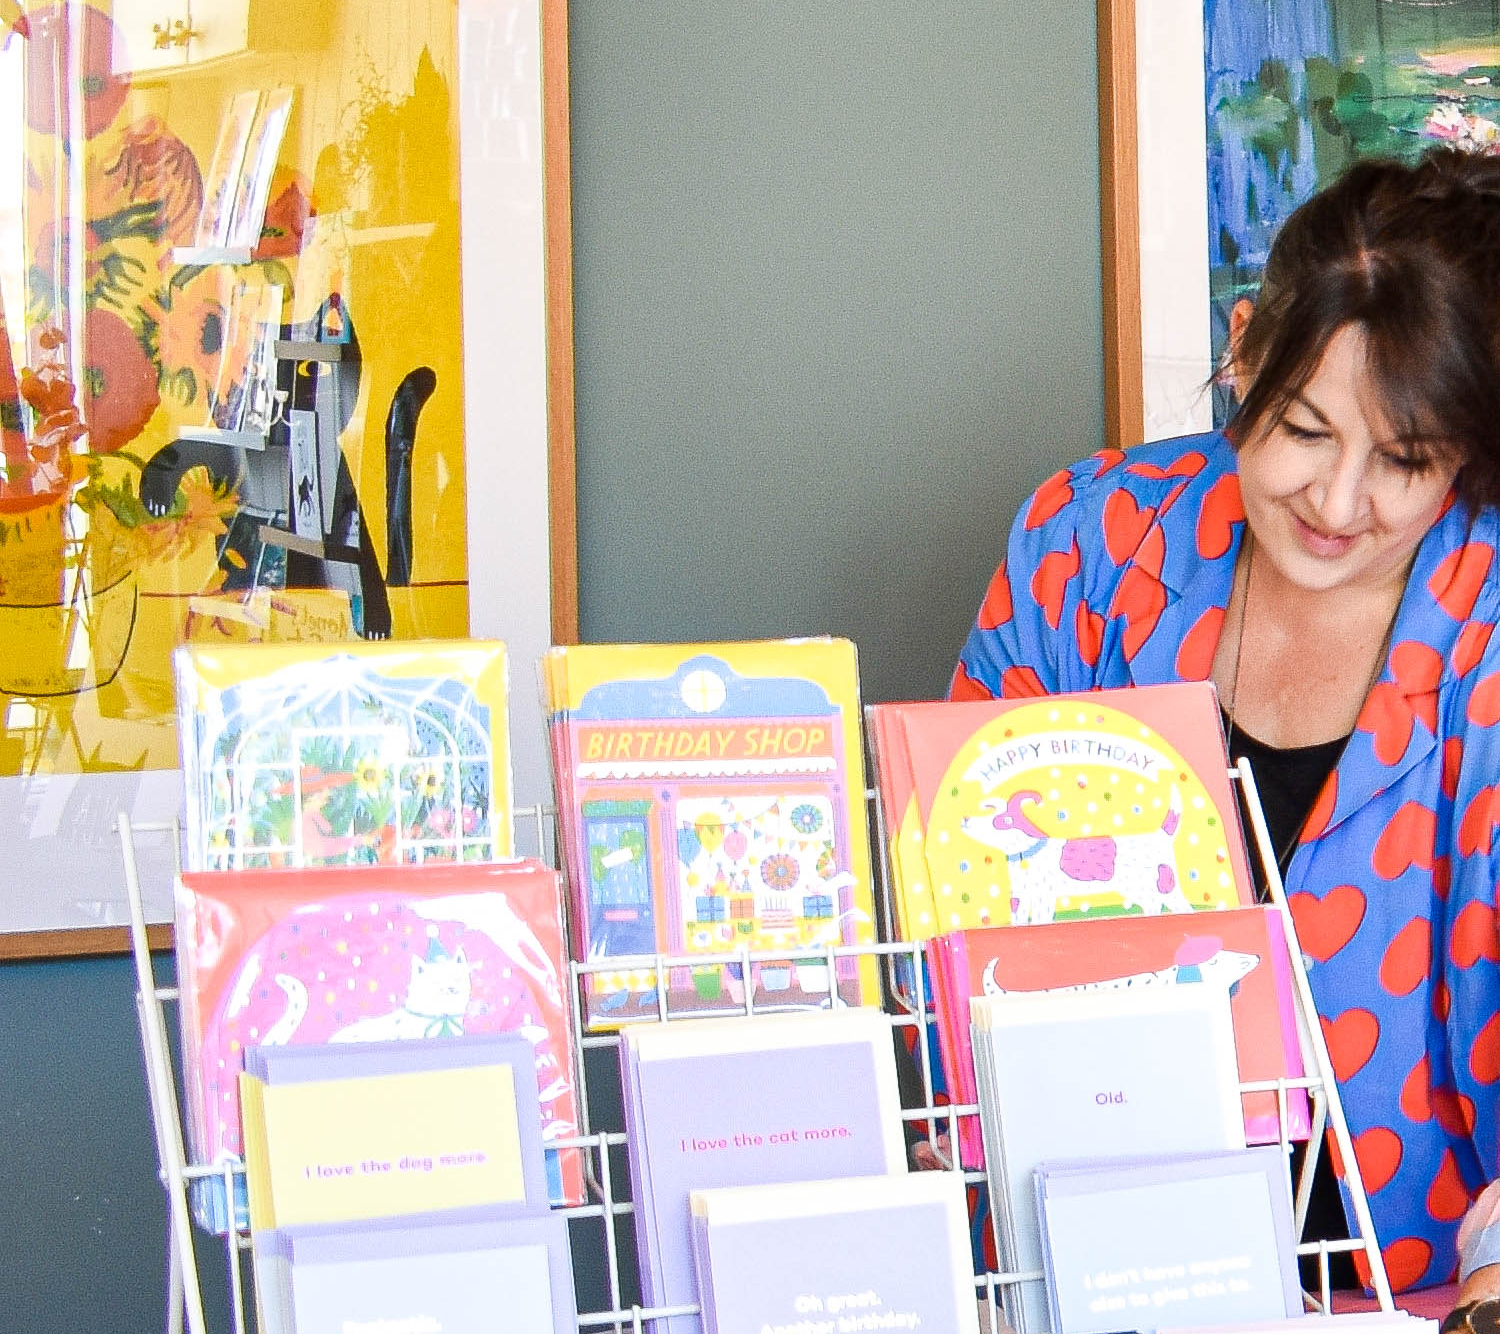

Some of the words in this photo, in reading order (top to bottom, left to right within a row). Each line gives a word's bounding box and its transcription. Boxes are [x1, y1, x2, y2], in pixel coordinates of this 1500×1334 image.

[586, 730, 735, 759] BIRTHDAY
[743, 727, 825, 755] SHOP
[980, 742, 1041, 781] HAPPY
[1050, 739, 1155, 771] BIRTHDAY
[1095, 1091, 1128, 1105] Old.
[692, 1137, 728, 1151] love
[733, 1133, 763, 1147] the
[769, 1130, 799, 1144] cat
[804, 1126, 852, 1140] more.
[316, 1163, 354, 1178] love
[360, 1160, 392, 1172] the
[399, 1154, 433, 1171] dog
[794, 1294, 824, 1313] Oh
